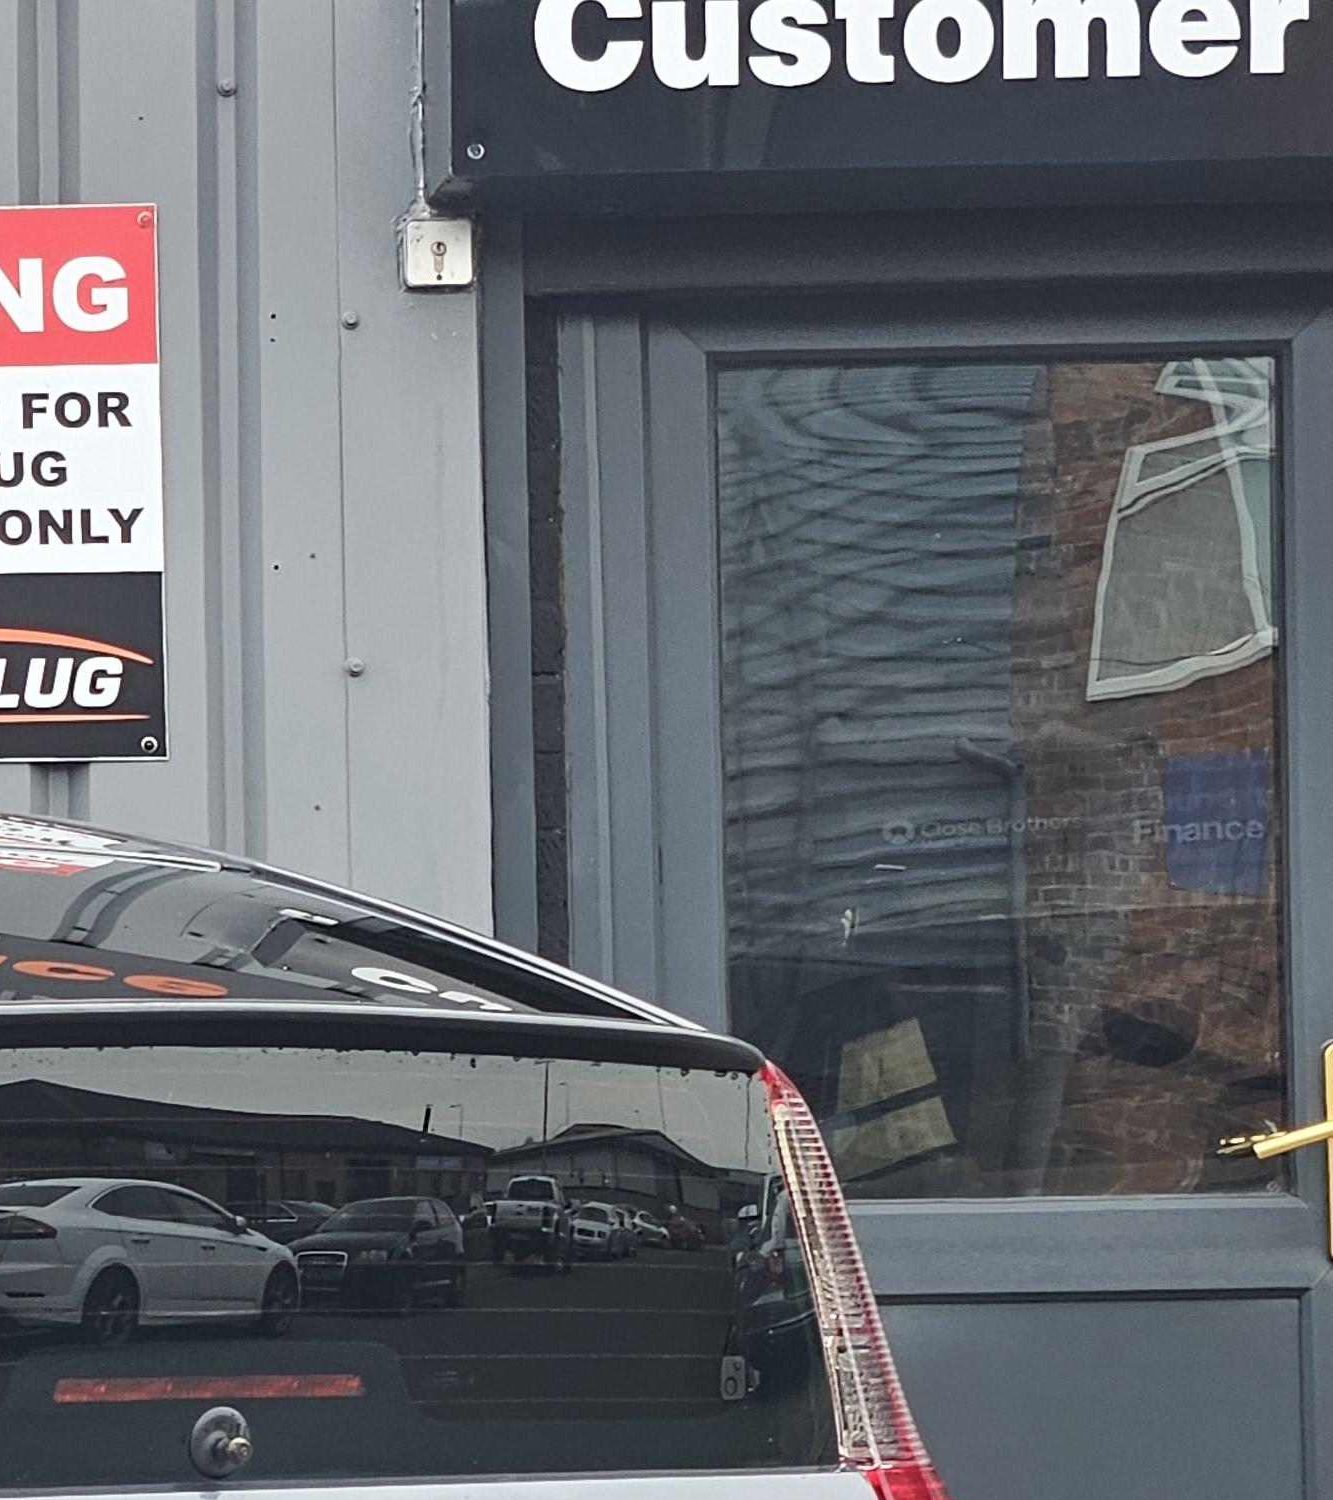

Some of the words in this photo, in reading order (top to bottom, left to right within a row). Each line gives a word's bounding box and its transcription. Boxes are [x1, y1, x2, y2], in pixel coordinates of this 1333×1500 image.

[533, 0, 1310, 92] Customer
[21, 391, 132, 430] FOR
[1133, 818, 1265, 845] Finance
